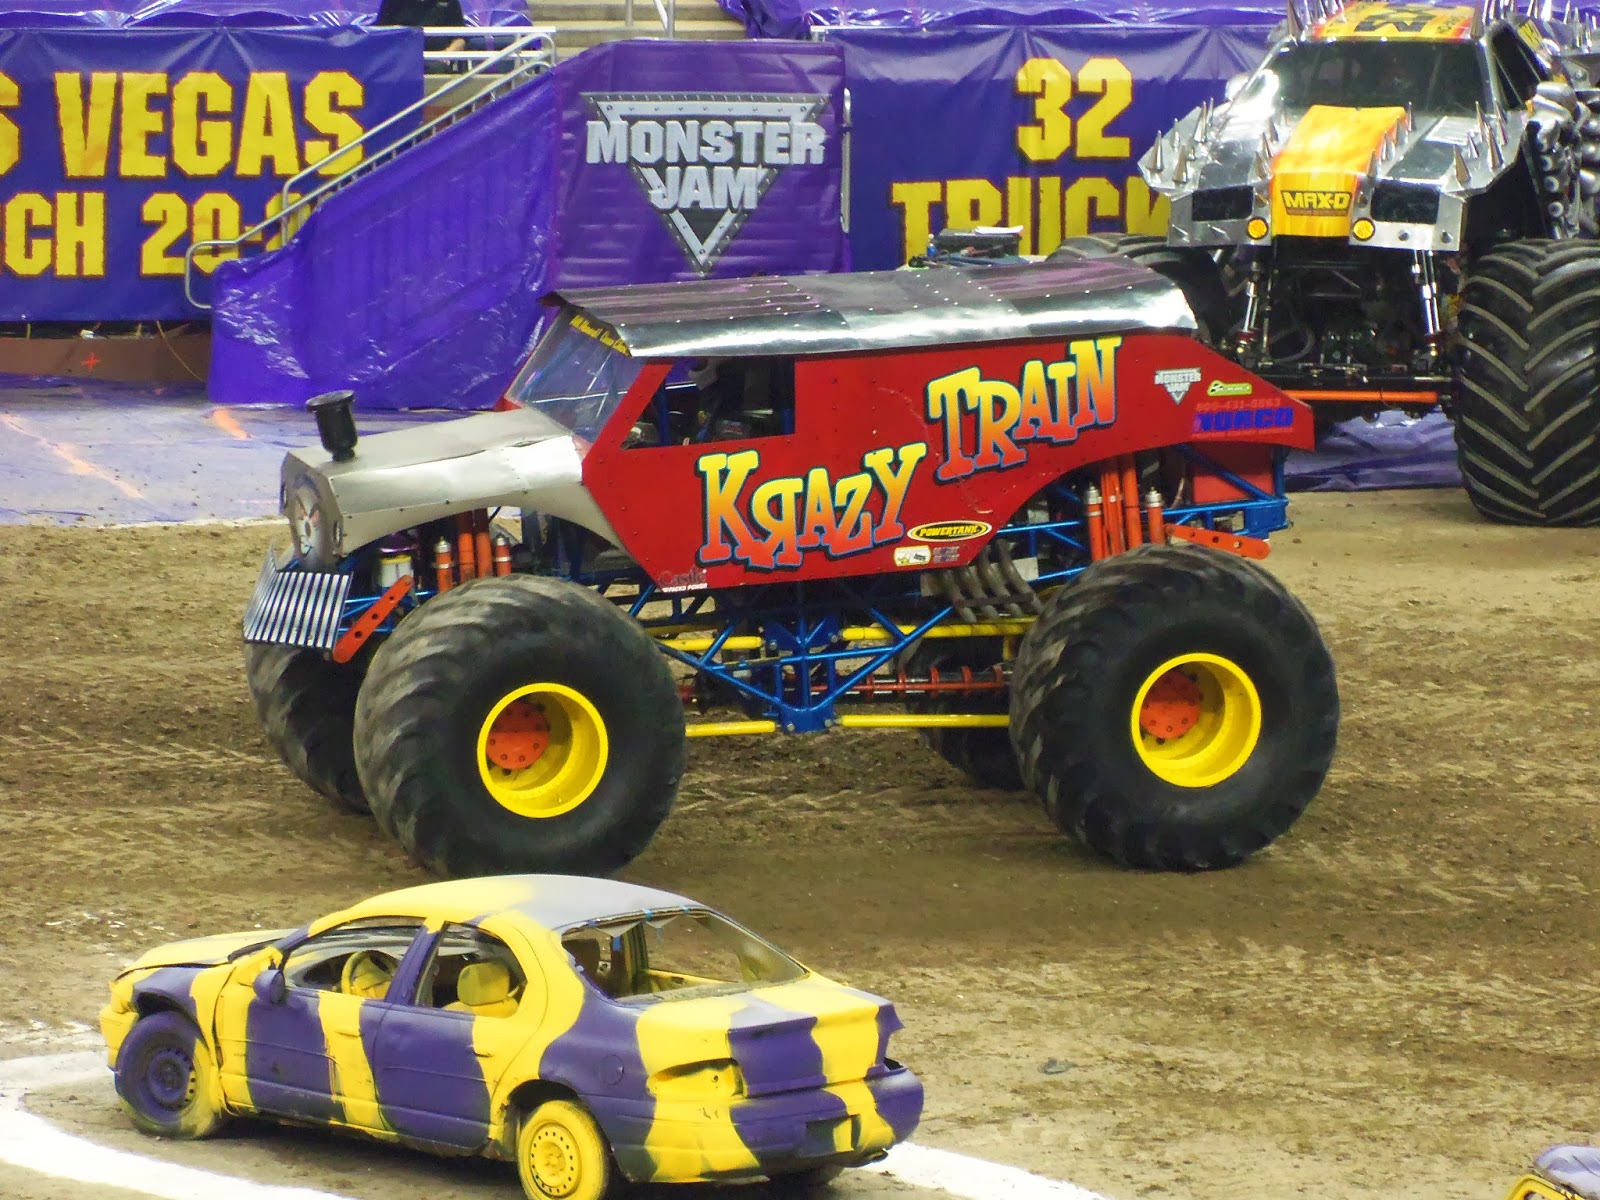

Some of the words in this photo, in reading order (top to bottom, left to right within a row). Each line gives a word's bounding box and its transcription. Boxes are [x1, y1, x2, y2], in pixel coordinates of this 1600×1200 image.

[54, 70, 364, 178] VEGAS
[585, 119, 827, 165] MONSTER
[1015, 57, 1133, 161] 32
[647, 165, 759, 210] JAM
[1282, 191, 1351, 210] MAX-D
[926, 335, 1122, 483] TRAIN
[697, 441, 928, 571] KRAZY
[918, 524, 979, 538] POWERTANK
